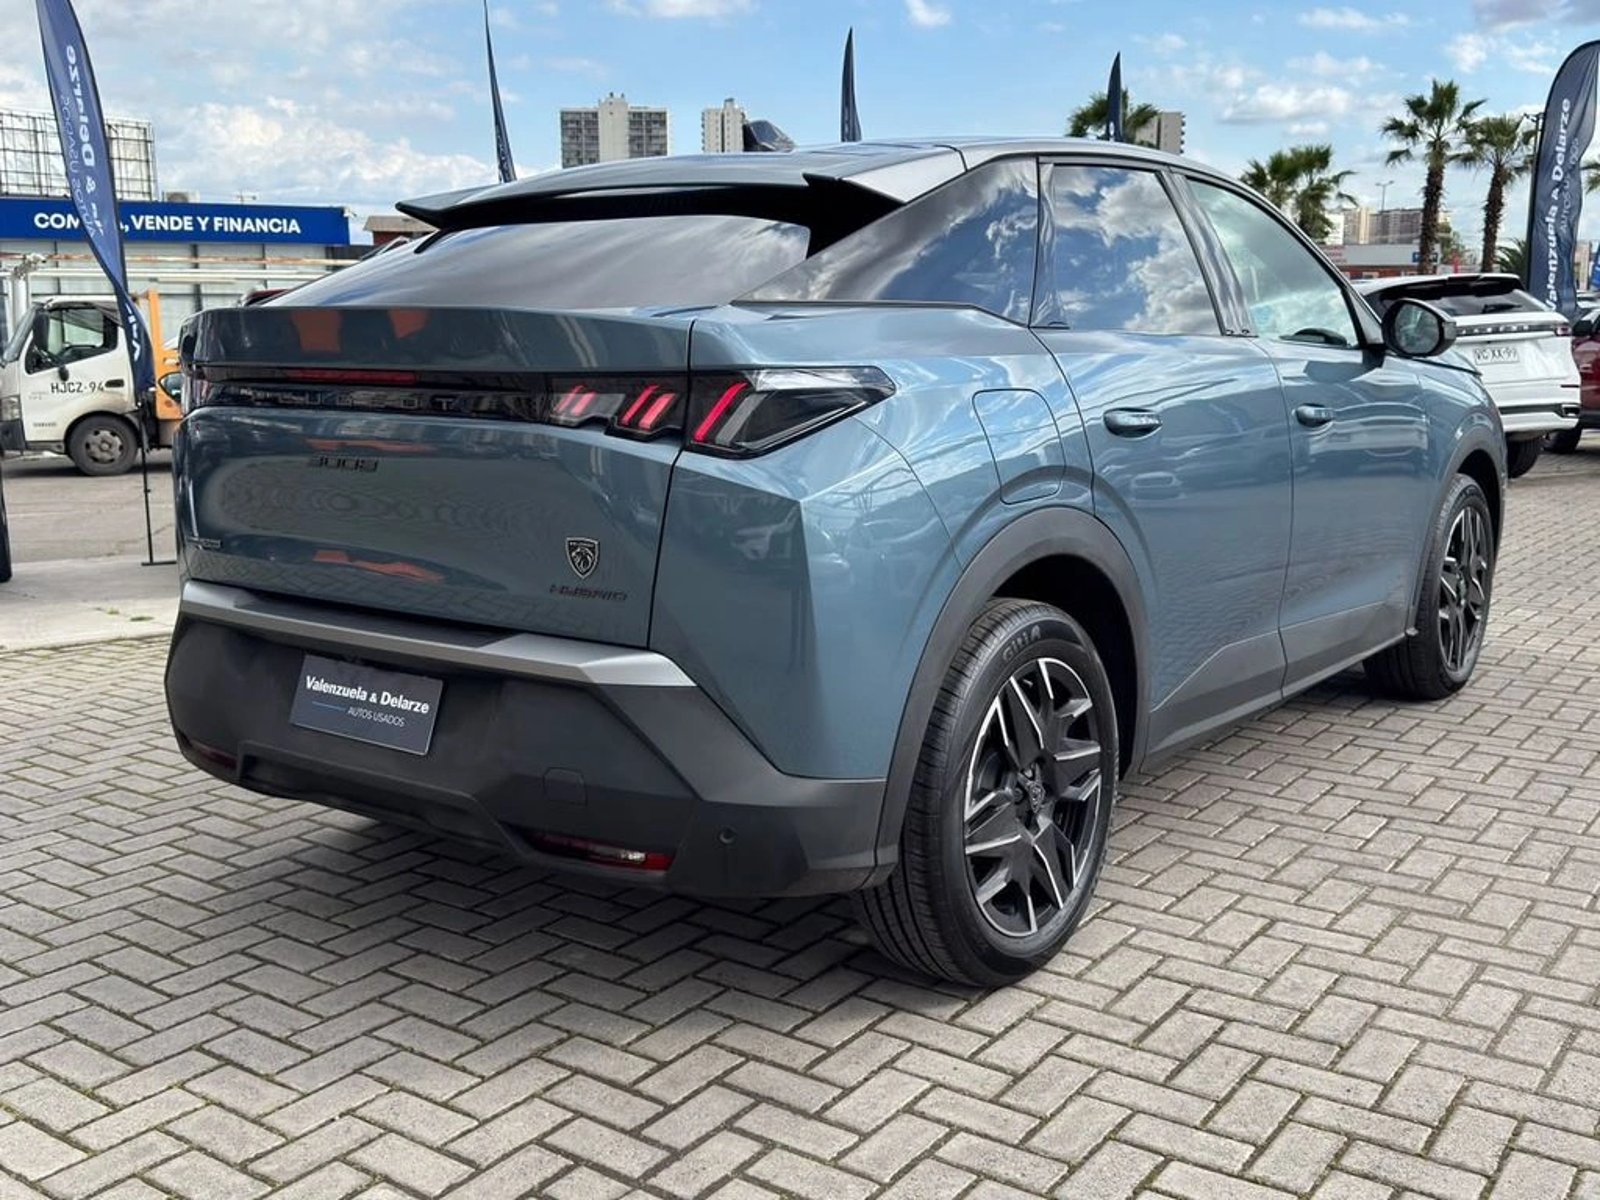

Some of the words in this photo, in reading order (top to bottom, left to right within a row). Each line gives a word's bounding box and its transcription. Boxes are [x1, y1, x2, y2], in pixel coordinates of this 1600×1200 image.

[1551, 98, 1571, 182] Delarze
[34, 212, 129, 233] COM,
[130, 214, 194, 231] VENDE
[196, 216, 210, 232] Y
[213, 216, 301, 234] FINANCIA
[306, 675, 368, 701] Valenzuela
[369, 692, 378, 703] &
[380, 691, 430, 714] Delarze
[347, 706, 373, 721] AUTOS
[373, 712, 405, 727] USADOS
